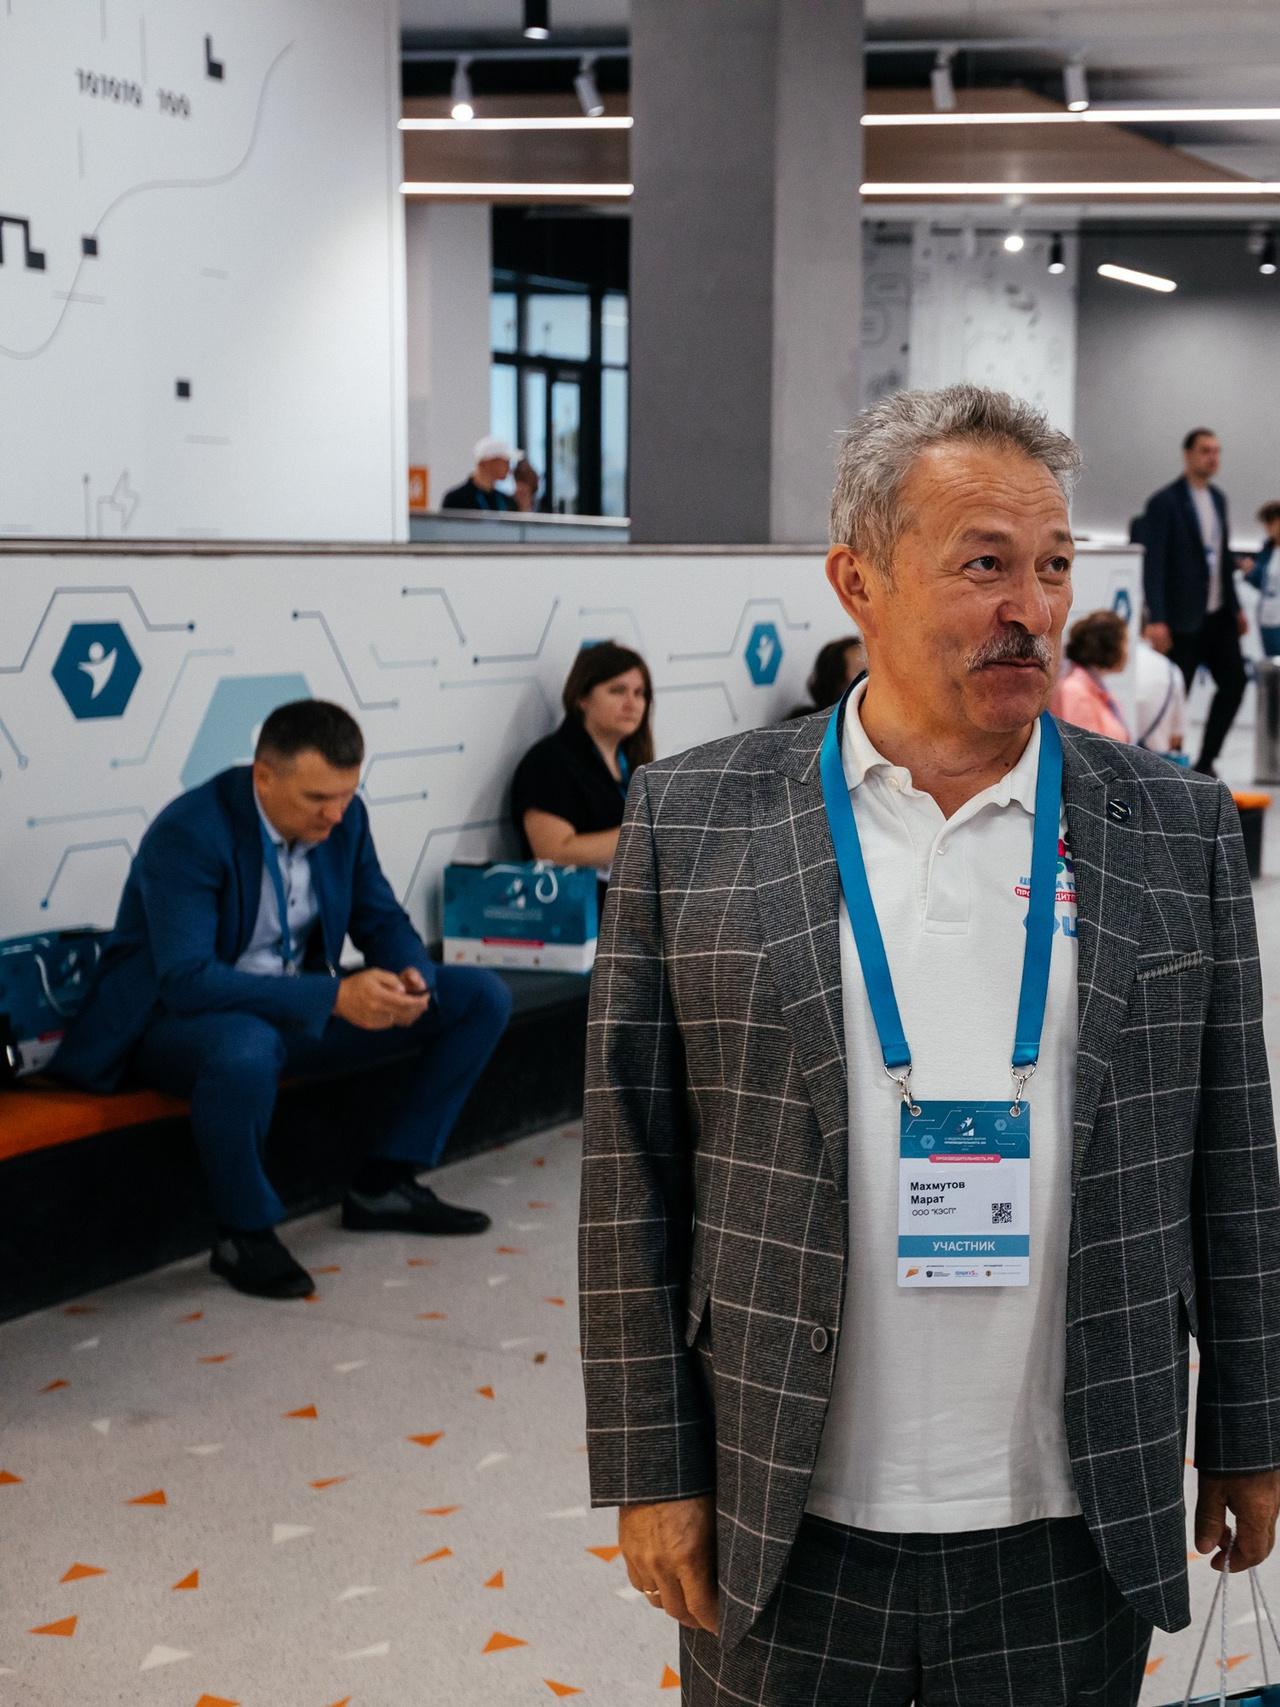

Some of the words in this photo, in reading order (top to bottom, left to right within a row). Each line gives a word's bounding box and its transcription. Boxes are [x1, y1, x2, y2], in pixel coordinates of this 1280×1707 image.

[910, 1181, 966, 1192] Махмутов
[910, 1195, 945, 1206] Марат
[911, 1208, 930, 1217] ООО
[932, 1241, 996, 1252] УЧАСТНИК
